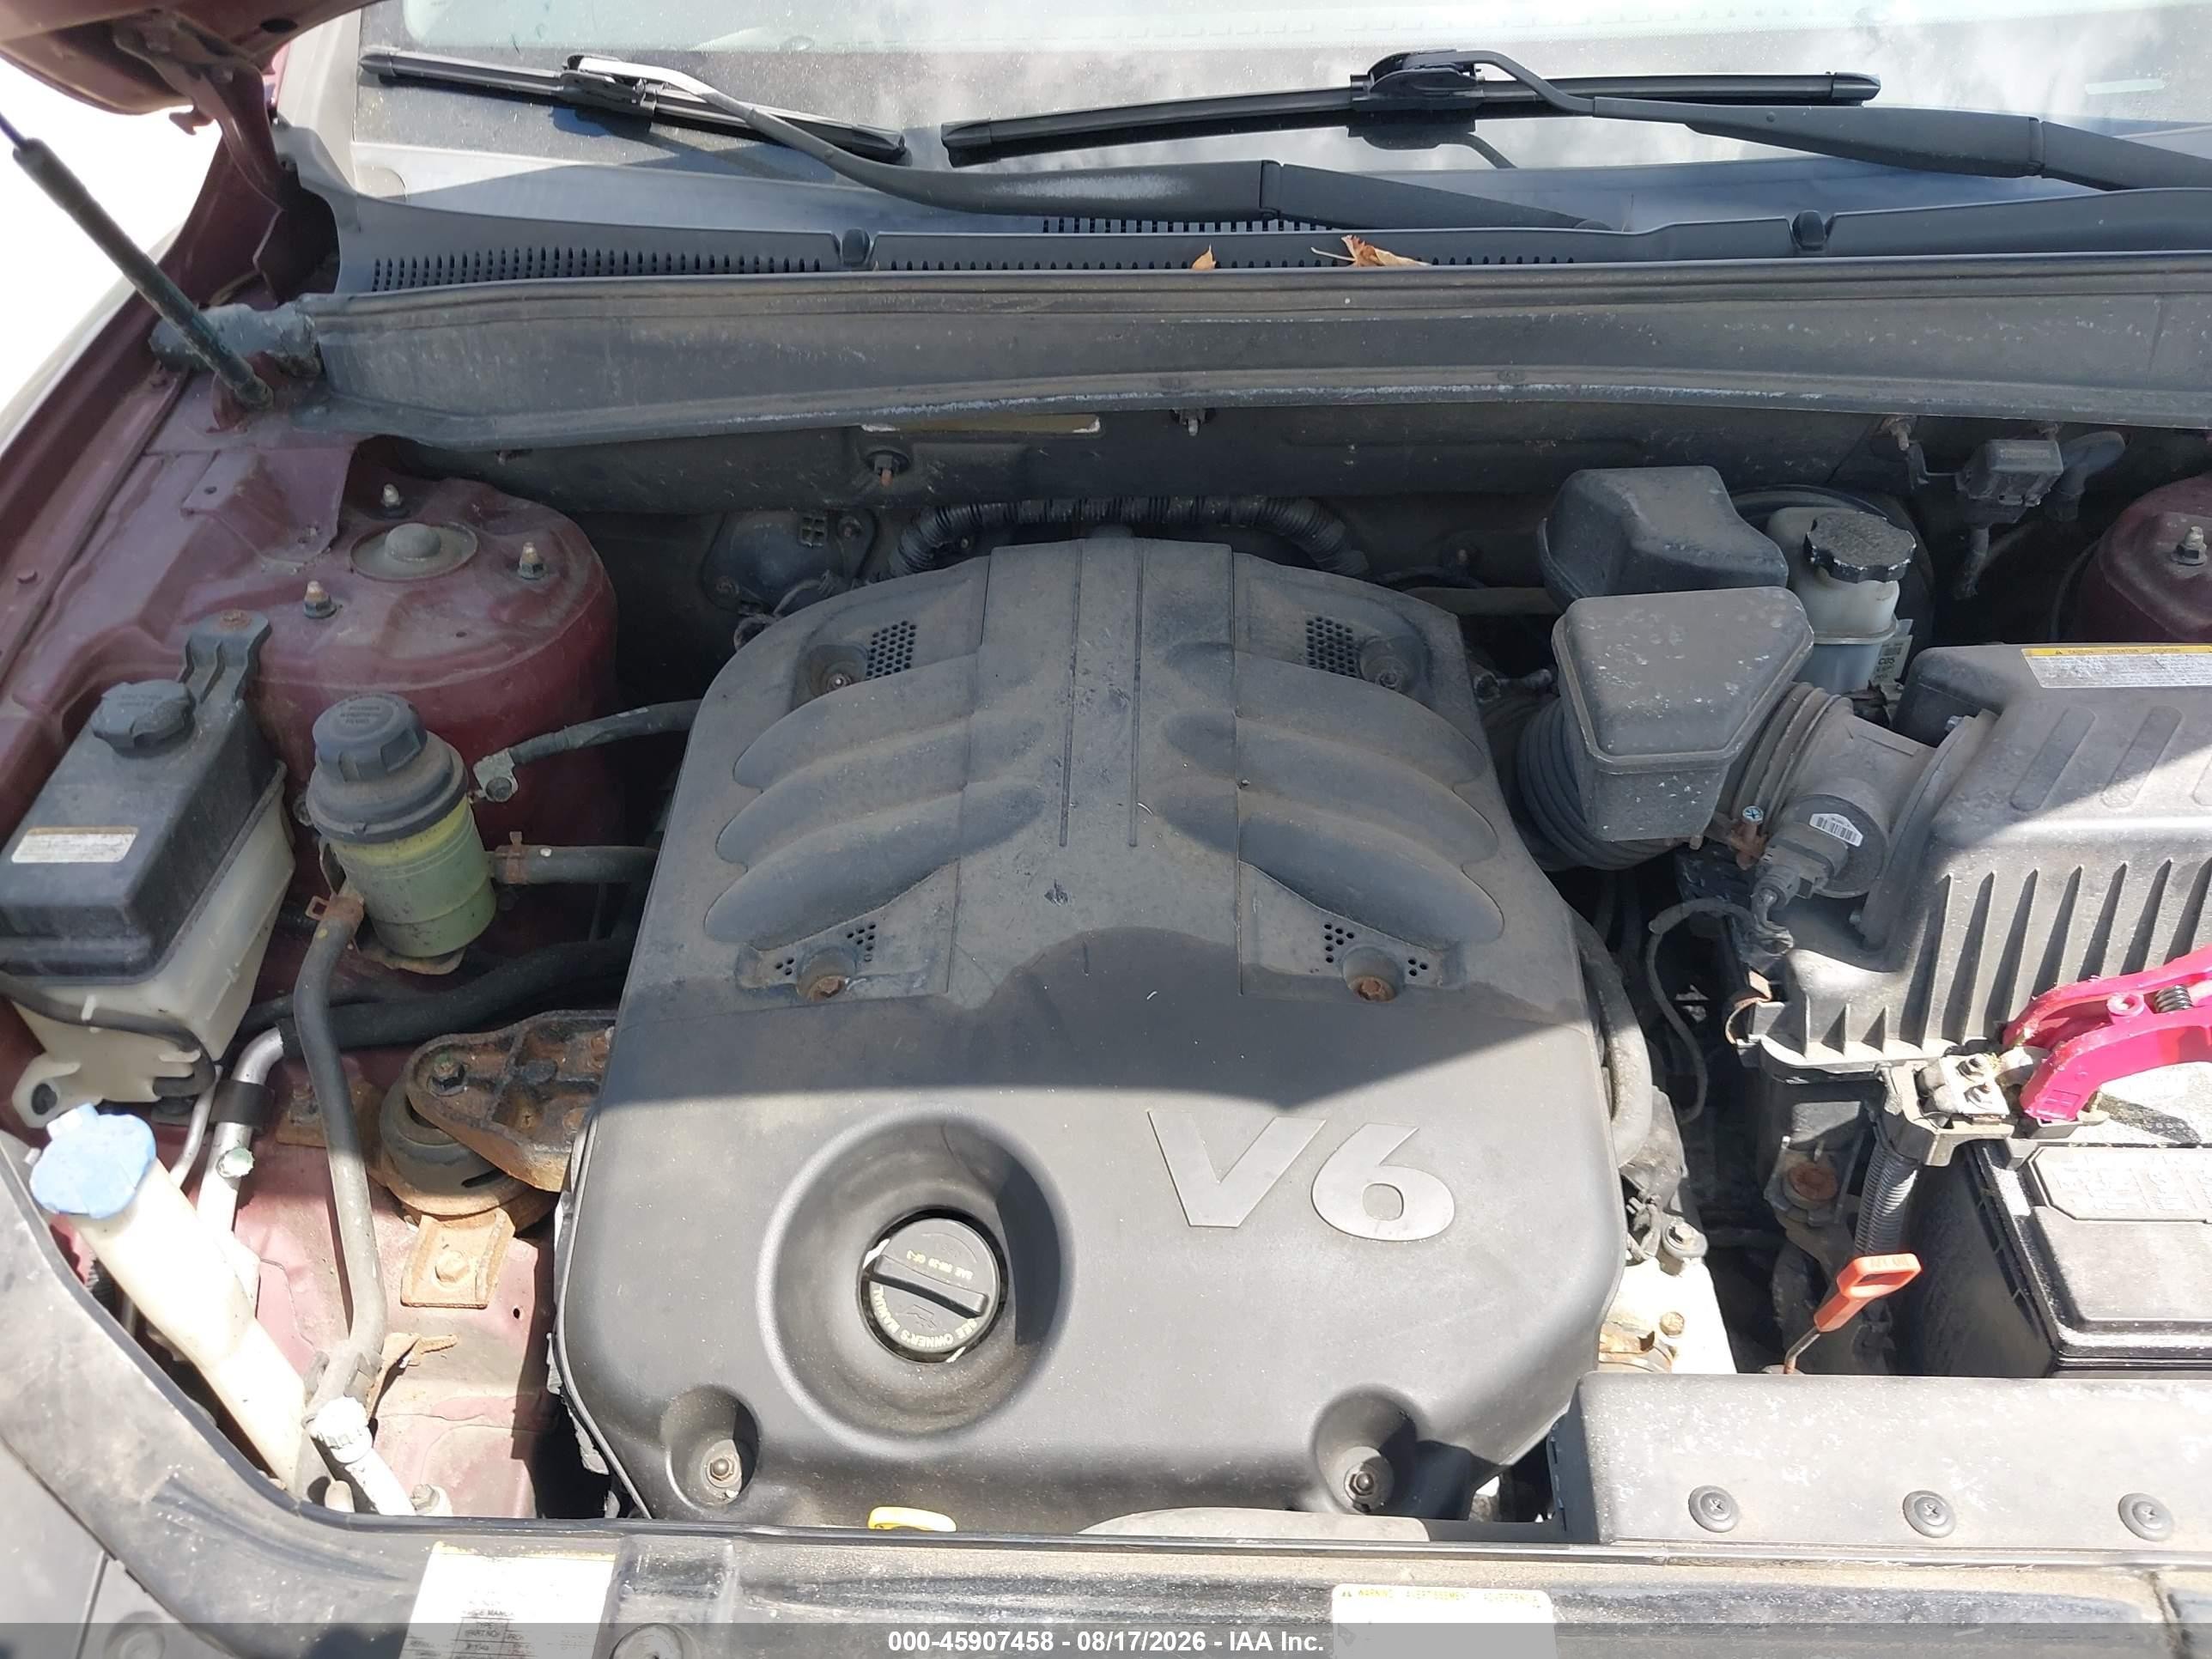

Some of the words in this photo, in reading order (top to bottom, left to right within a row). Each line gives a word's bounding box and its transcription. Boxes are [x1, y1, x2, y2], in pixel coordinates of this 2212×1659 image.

[1148, 1111, 1455, 1241] V6
[872, 1285, 901, 1334] MANUAL
[900, 1329, 953, 1347] OWNER'S
[954, 1318, 977, 1340] SEE
